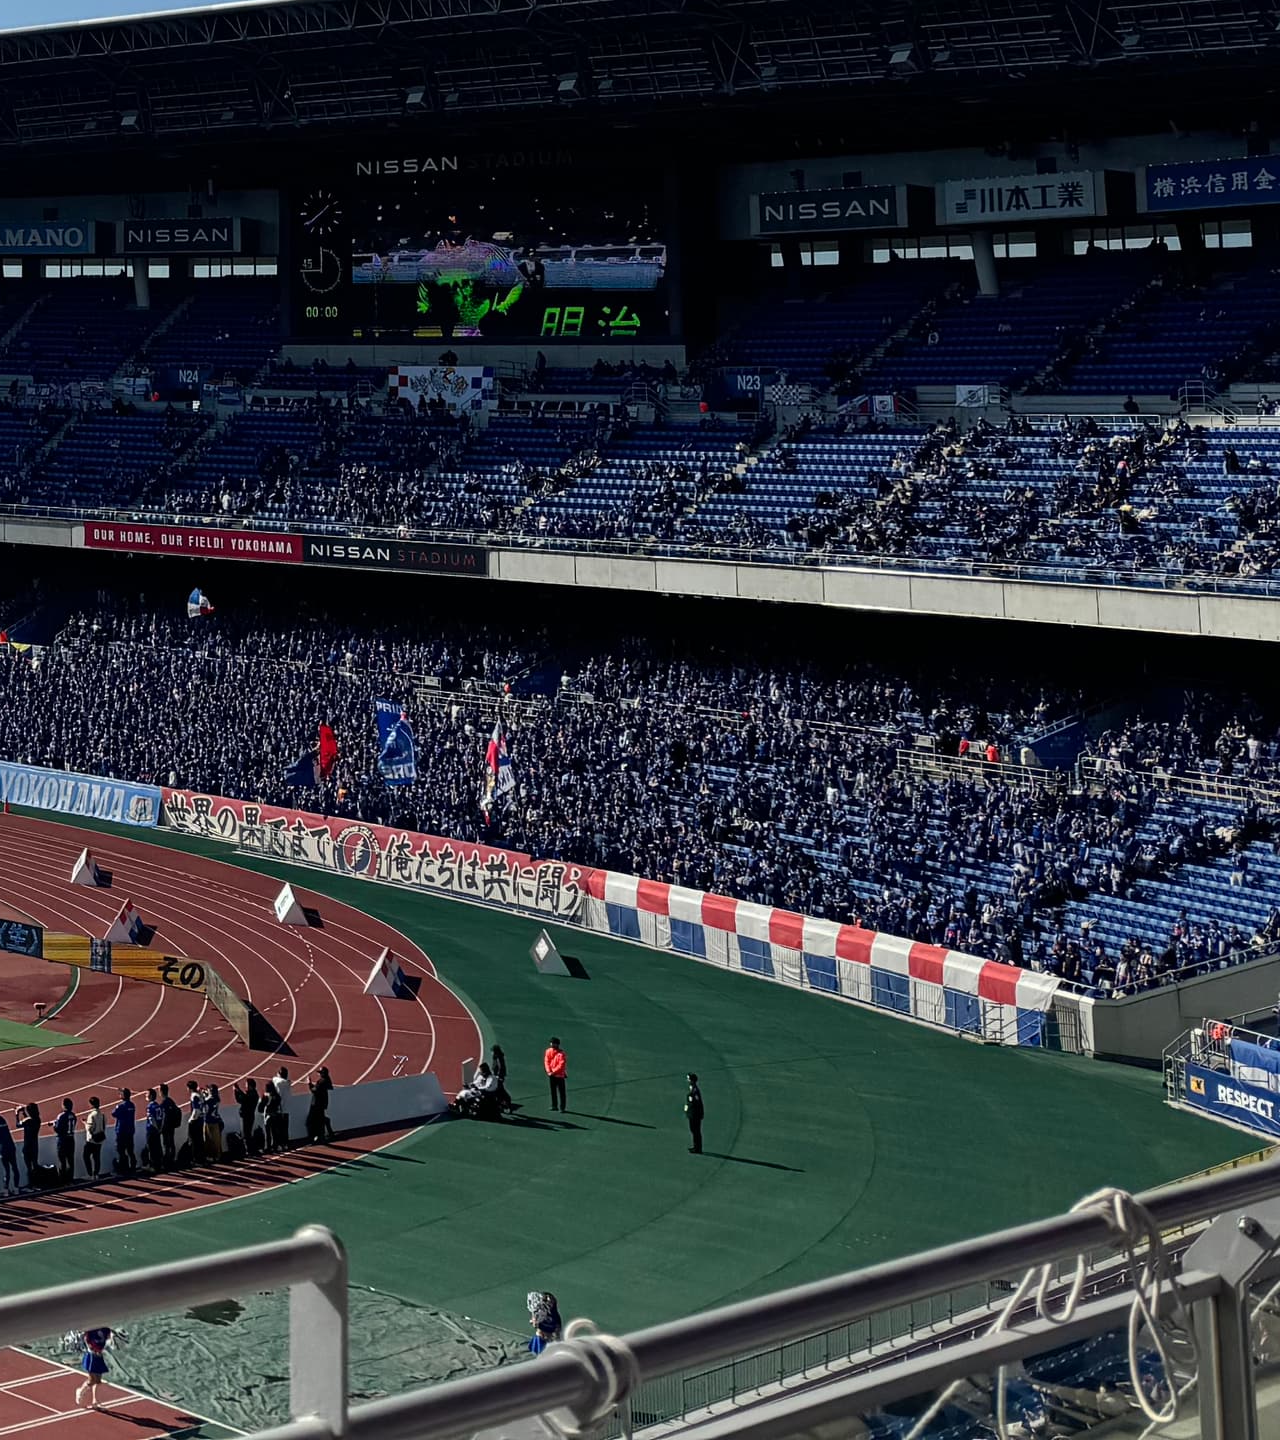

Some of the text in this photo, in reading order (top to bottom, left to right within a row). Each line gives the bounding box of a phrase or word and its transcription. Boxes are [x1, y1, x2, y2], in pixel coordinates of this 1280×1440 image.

[356, 149, 573, 176] NISSAN STADIUM
[1153, 167, 1277, 198] 横浜信用金
[765, 198, 889, 221] NISSAN
[980, 181, 1084, 213] 川本工業
[128, 227, 228, 244] NISSAN
[305, 305, 339, 319] 00:00
[179, 369, 199, 383] N24
[737, 375, 761, 391] N23
[93, 528, 293, 554] OUR HOME, OUR FIELD! YOKOHAMA
[310, 543, 476, 567] NISSAN STADIUM
[0, 769, 125, 822] YOKOHAMA
[158, 956, 205, 989] その
[1217, 1084, 1274, 1119] RESPECT
